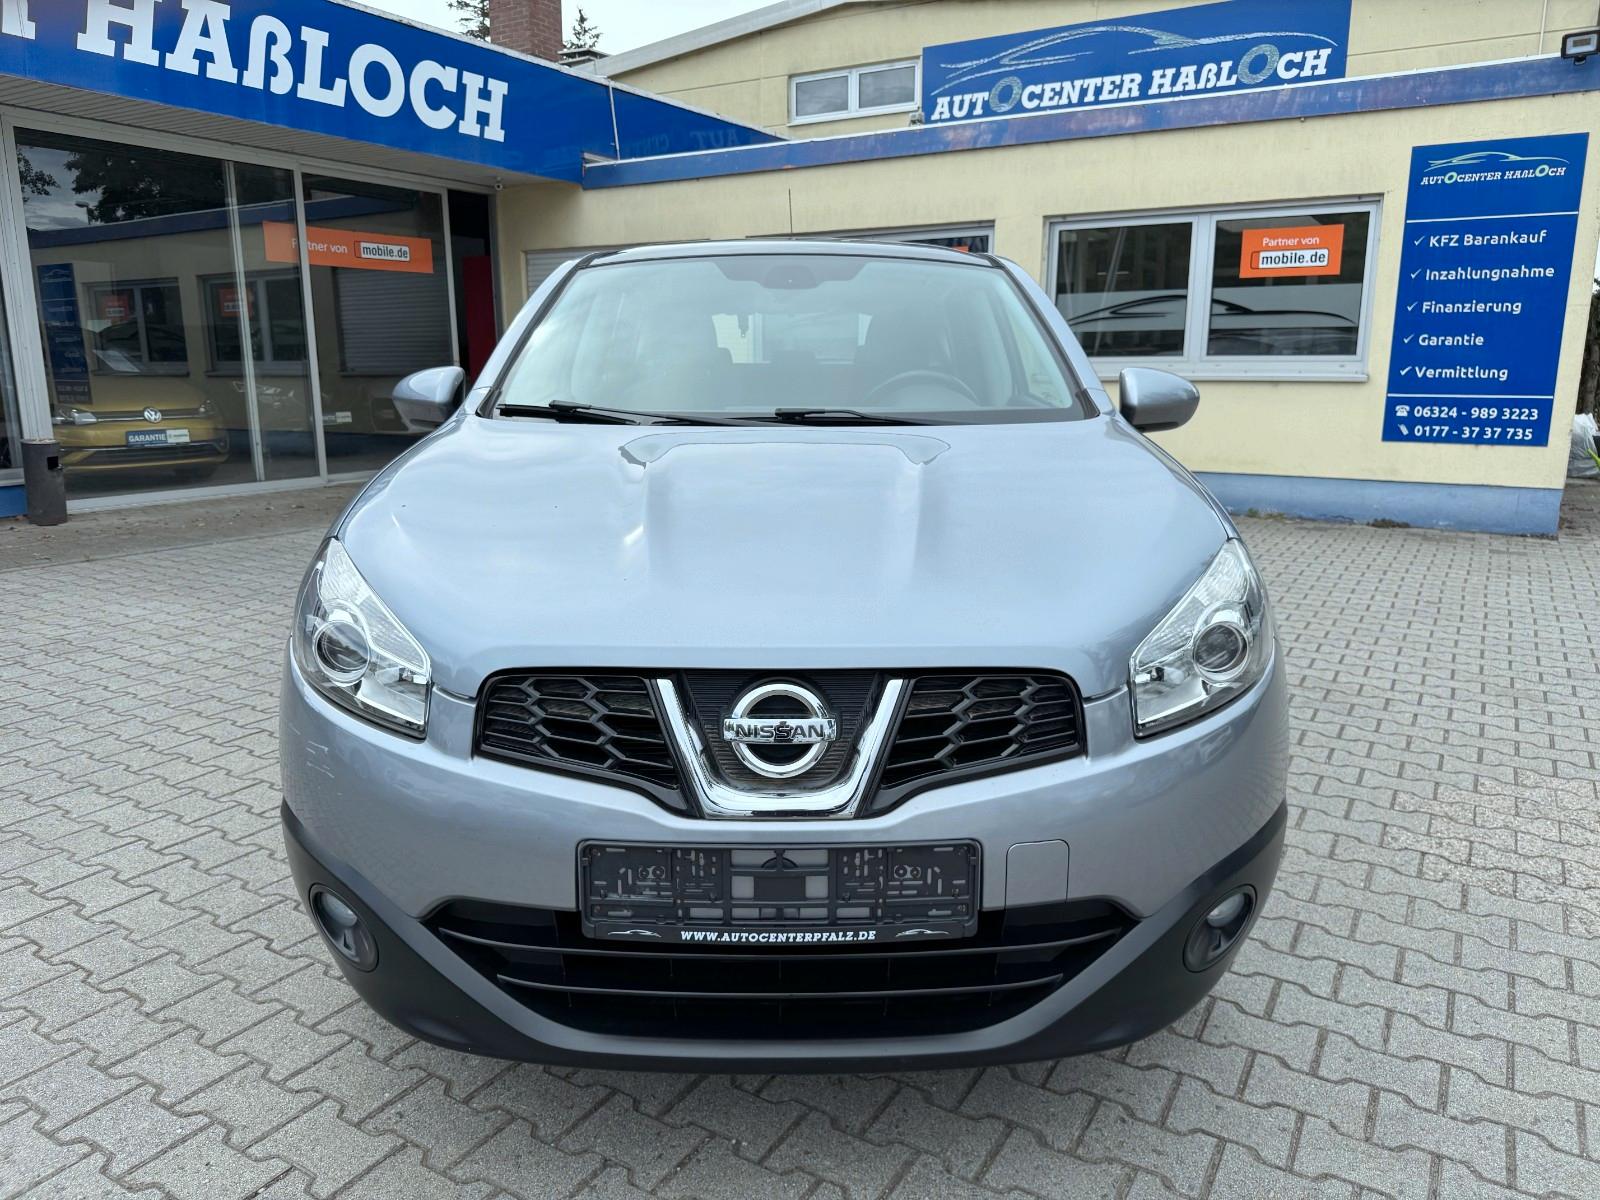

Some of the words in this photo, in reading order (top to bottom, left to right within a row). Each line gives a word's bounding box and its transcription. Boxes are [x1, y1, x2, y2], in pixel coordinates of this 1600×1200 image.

[931, 73, 1141, 121] AUTOCENTER
[1148, 43, 1332, 96] HAßLOCH
[1420, 171, 1502, 185] AUTOCENTER
[1504, 164, 1567, 180] HAßLOCH
[1262, 237, 1298, 247] Partner
[1301, 237, 1320, 246] von
[1429, 234, 1460, 247] KFZ
[1463, 230, 1548, 246] Barankauf
[330, 243, 348, 254] von
[362, 244, 409, 259] mobile.de
[1261, 251, 1326, 265] mobile.de
[1425, 265, 1555, 281] Inzahlungnahme
[1421, 300, 1522, 314] Finanzierung
[1418, 333, 1485, 346] Garantie
[1414, 366, 1509, 381] Vermittlung
[1413, 406, 1458, 419] 06324
[1471, 407, 1498, 419] 989
[1501, 408, 1539, 421] 3223
[128, 434, 166, 443] GARANTIE
[1414, 425, 1450, 438] 0177
[1461, 426, 1481, 439] 37
[1483, 426, 1502, 439] 37
[1506, 427, 1534, 441] 735
[735, 723, 825, 739] NISSAN
[680, 930, 877, 943] WWW.AUTOCENTERPFALZ.DE
